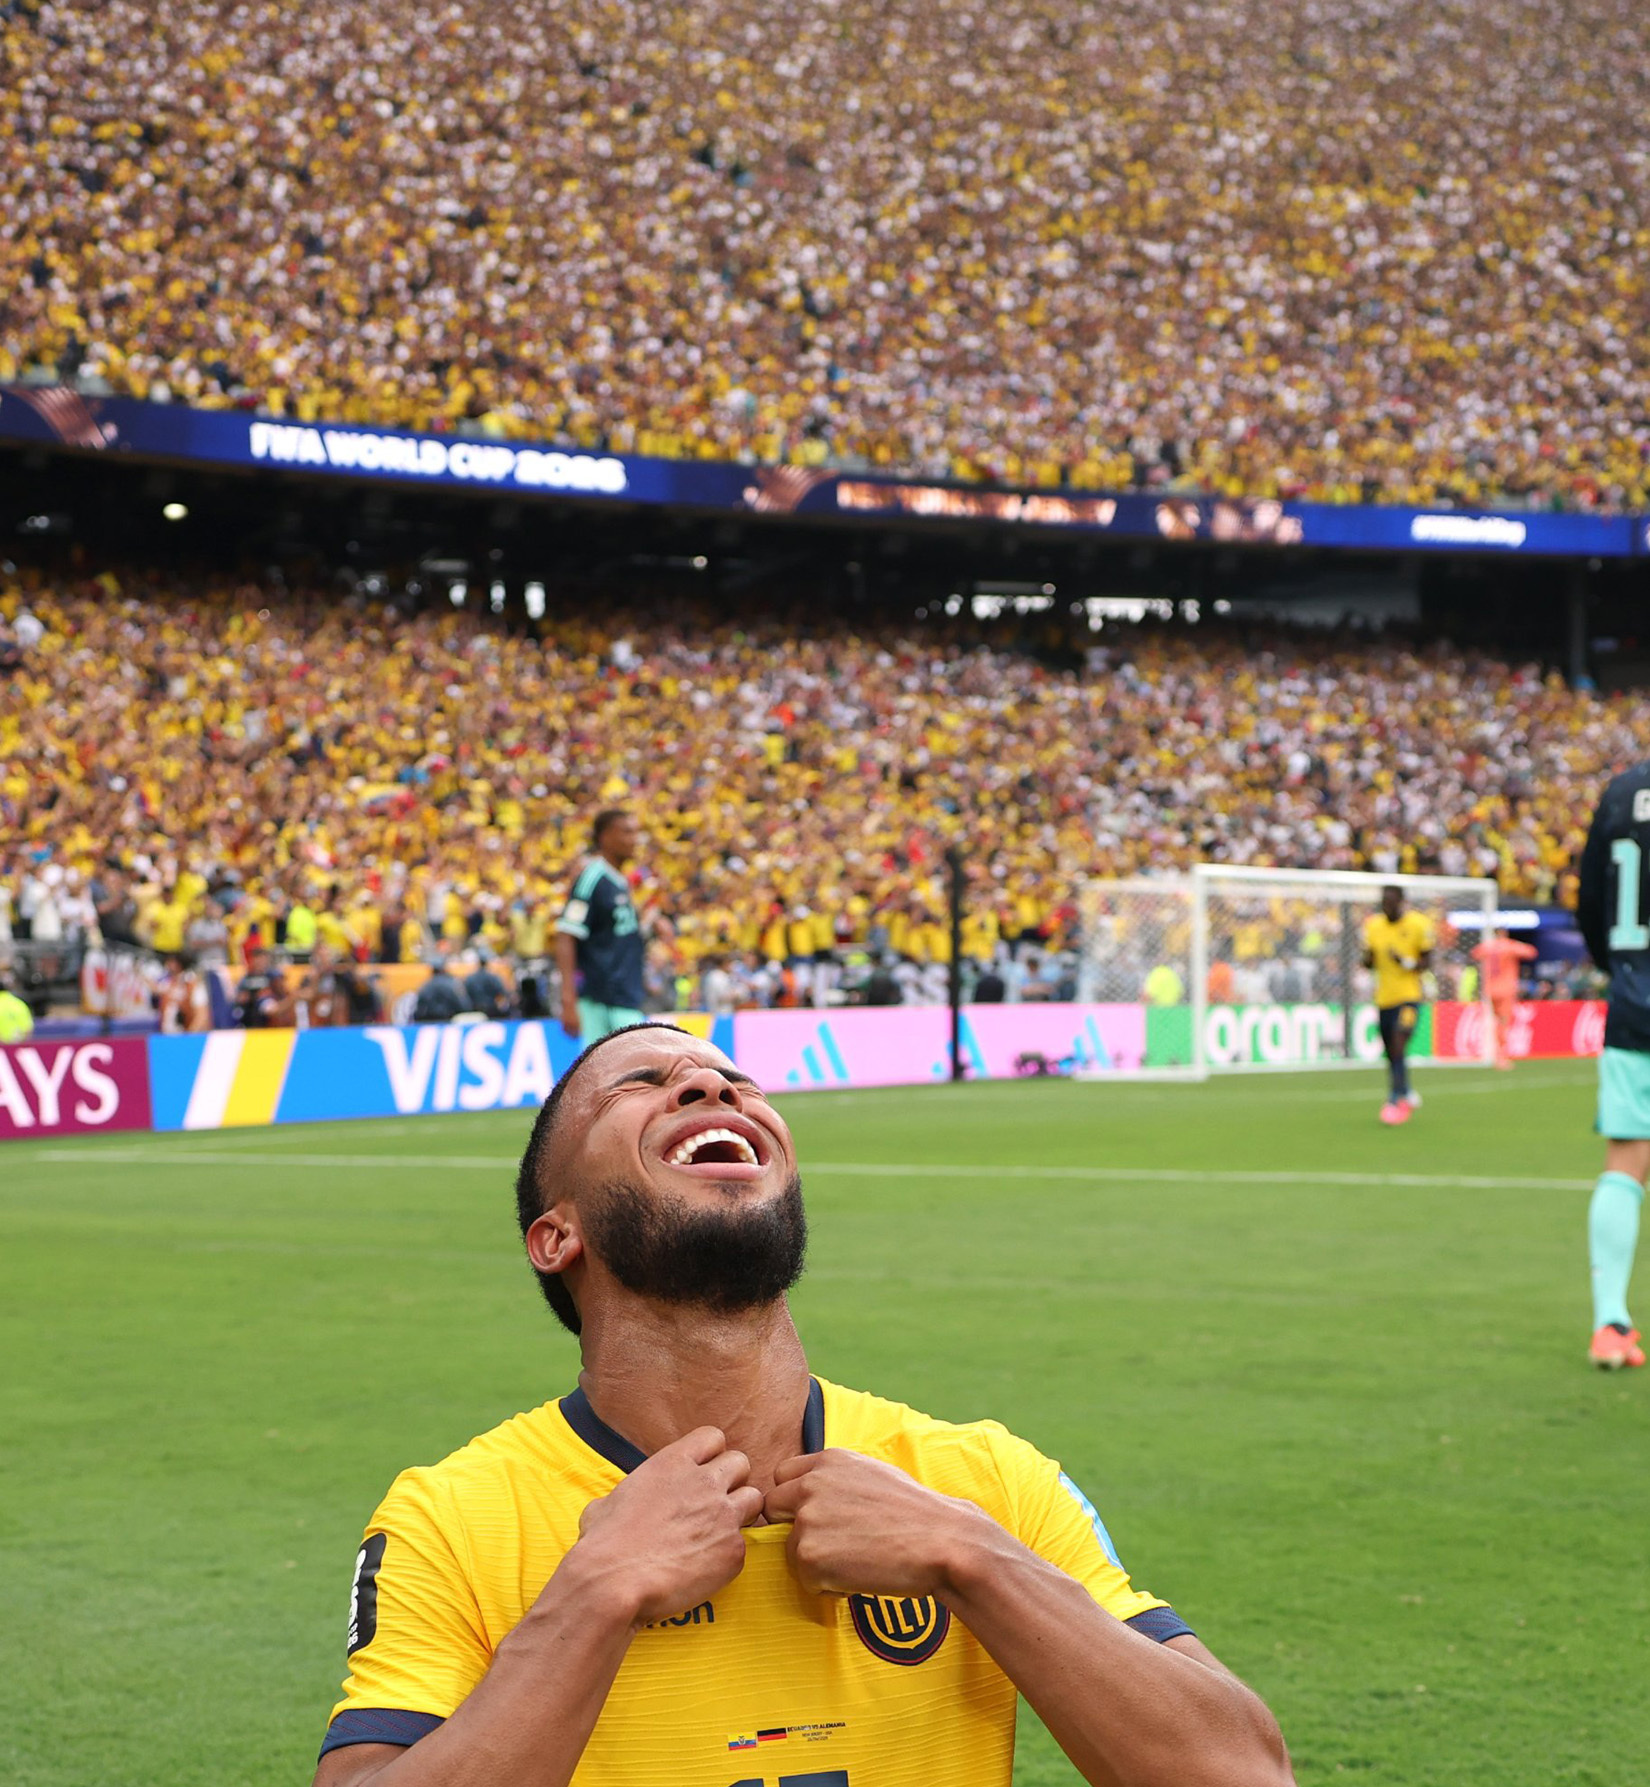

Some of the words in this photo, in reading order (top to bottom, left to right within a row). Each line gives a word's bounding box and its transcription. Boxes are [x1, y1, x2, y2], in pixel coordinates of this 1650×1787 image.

[250, 421, 328, 465] FIFA
[323, 430, 447, 476] WORLD
[448, 442, 516, 481] CUP
[1609, 837, 1650, 950] 1
[363, 1021, 554, 1114] VISA
